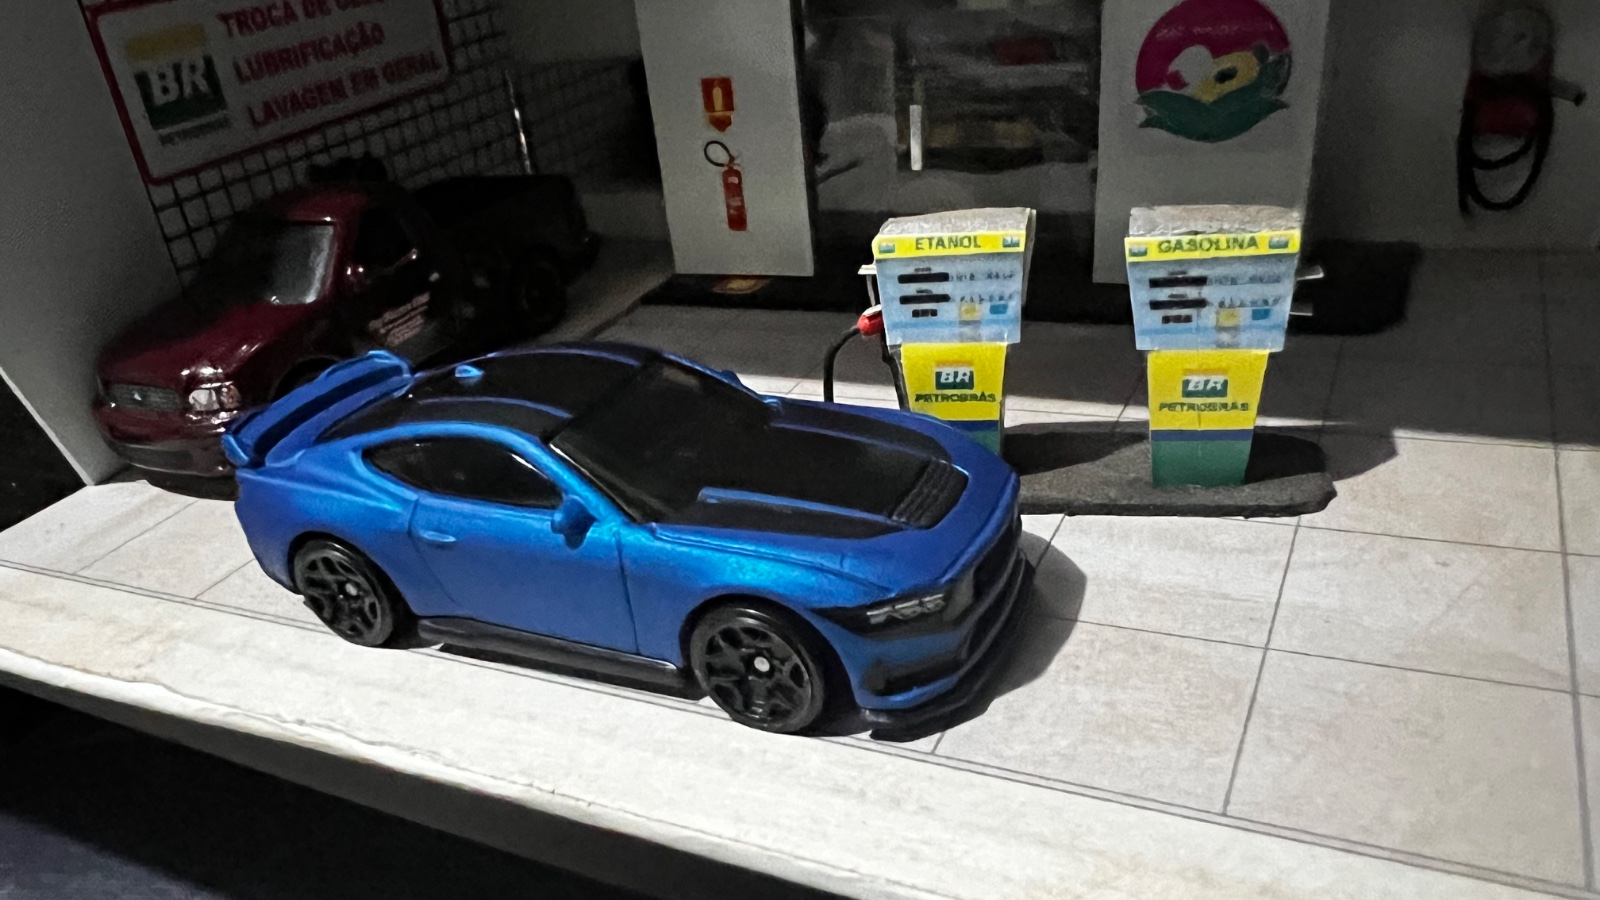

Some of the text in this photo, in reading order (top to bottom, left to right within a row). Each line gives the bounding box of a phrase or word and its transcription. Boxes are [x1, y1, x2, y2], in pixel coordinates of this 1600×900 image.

[216, 1, 299, 37] TROCA
[381, 51, 442, 84] GERAL
[148, 56, 213, 106] BR
[914, 234, 982, 251] ETANOL
[1157, 235, 1259, 254] GASOLINA
[940, 367, 971, 383] BR
[1187, 375, 1225, 391] BR
